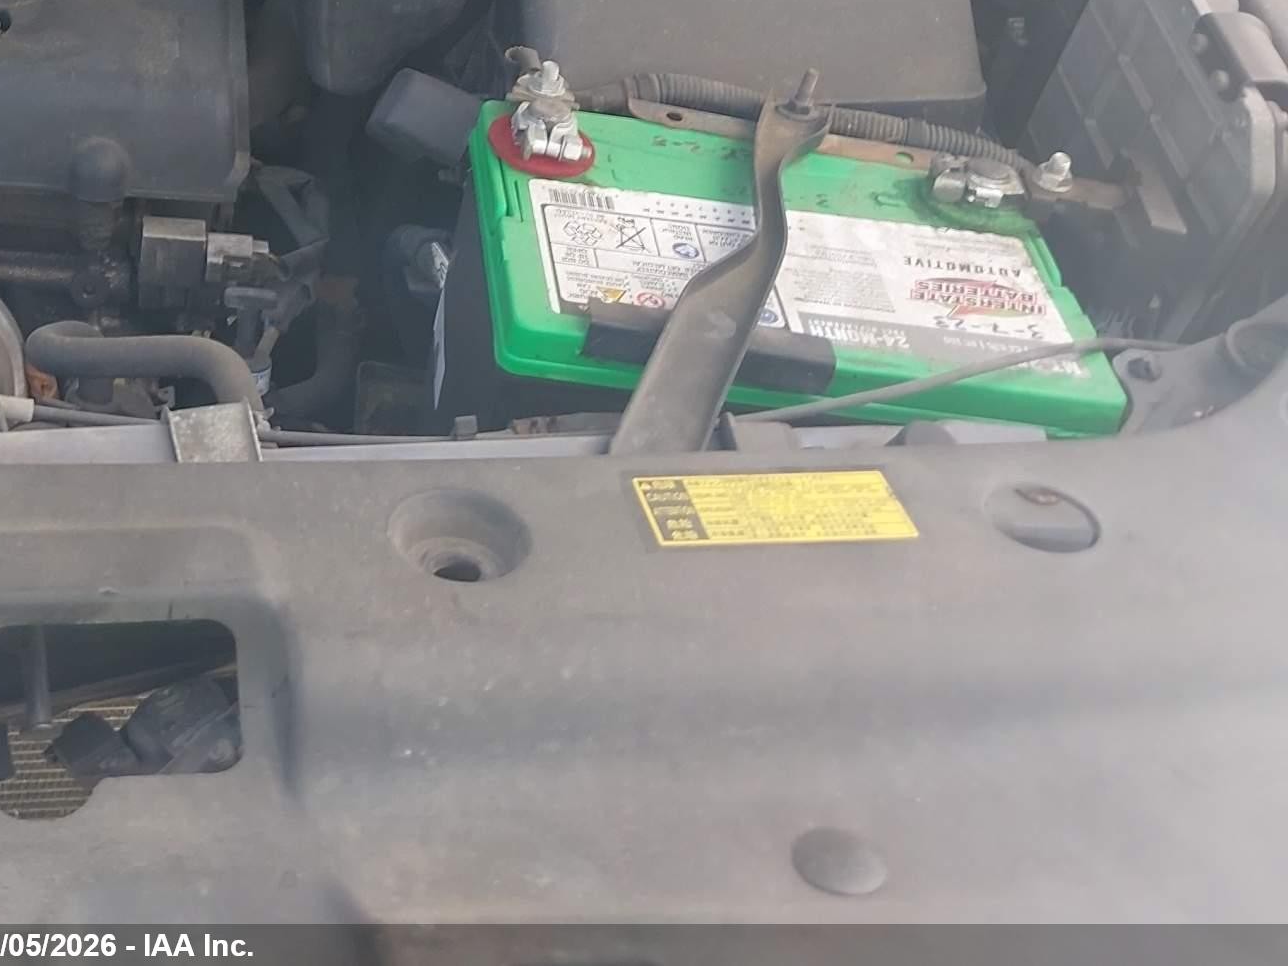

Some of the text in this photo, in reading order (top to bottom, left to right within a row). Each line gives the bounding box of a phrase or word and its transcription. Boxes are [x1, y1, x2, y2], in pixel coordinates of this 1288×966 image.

[903, 255, 1022, 278] AUTOMOTIVE
[912, 289, 1045, 316] INTERSTATE
[915, 280, 1034, 302] BATTERIES
